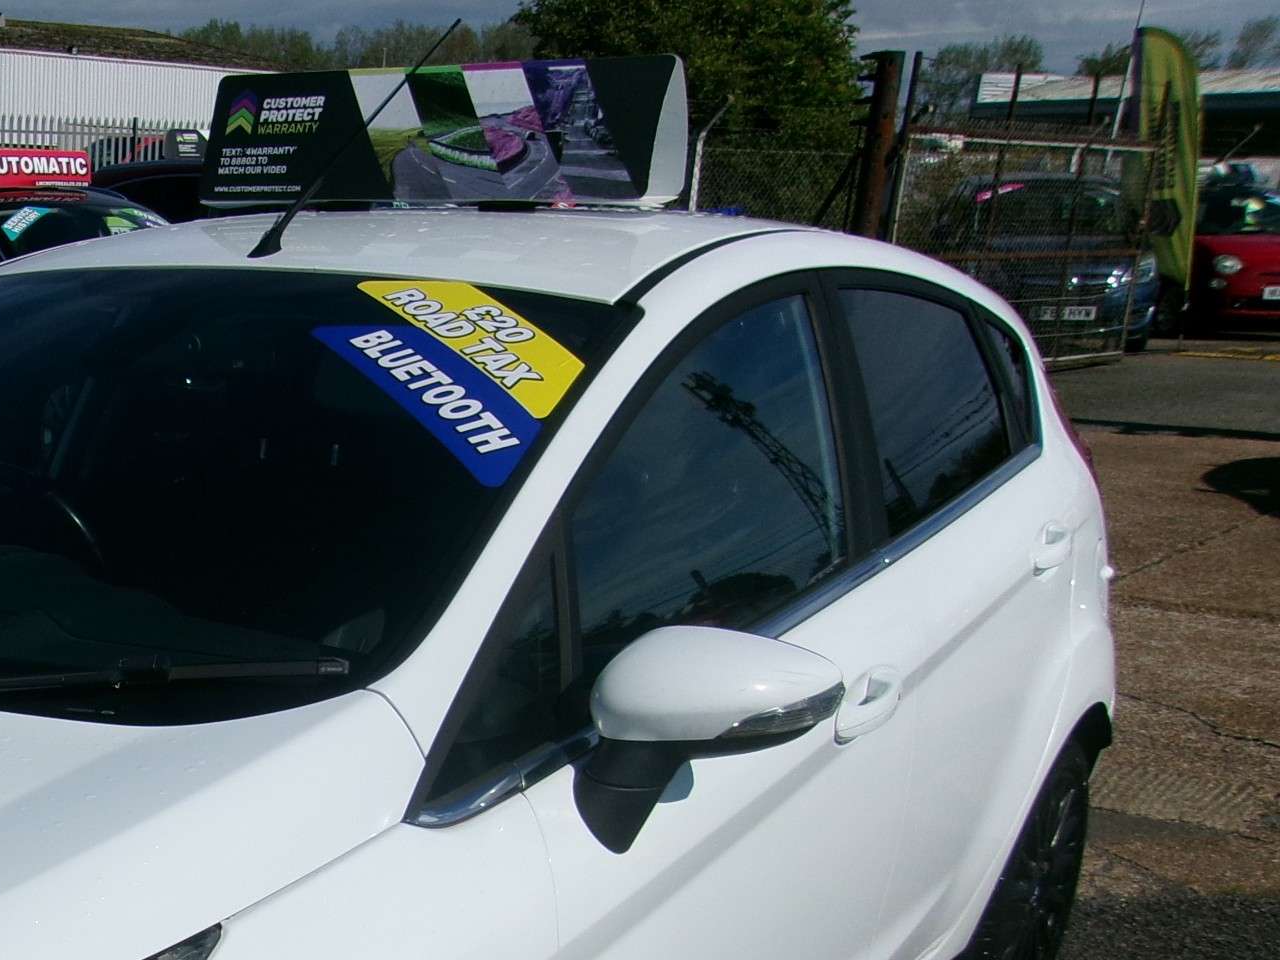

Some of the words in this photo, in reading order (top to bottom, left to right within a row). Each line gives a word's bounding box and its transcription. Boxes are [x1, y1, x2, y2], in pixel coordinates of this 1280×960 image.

[262, 96, 326, 109] CUSTOMER
[259, 107, 323, 123] PROTECT
[257, 121, 320, 135] WARRANTY
[221, 147, 243, 157] TEXT:
[219, 157, 230, 166] TO
[257, 156, 268, 165] TO
[217, 166, 245, 175] WATCH
[245, 165, 263, 175] OUR
[262, 165, 287, 174] VIDEO
[214, 185, 302, 193] WWW.CUSTOMERPROTECT.COM
[5, 206, 34, 230] SERVICE
[14, 210, 42, 234] HISTORY
[461, 304, 536, 345] £20
[383, 287, 476, 339] ROAD
[460, 336, 545, 390] TAX
[348, 329, 521, 455] BLUETOOTH
